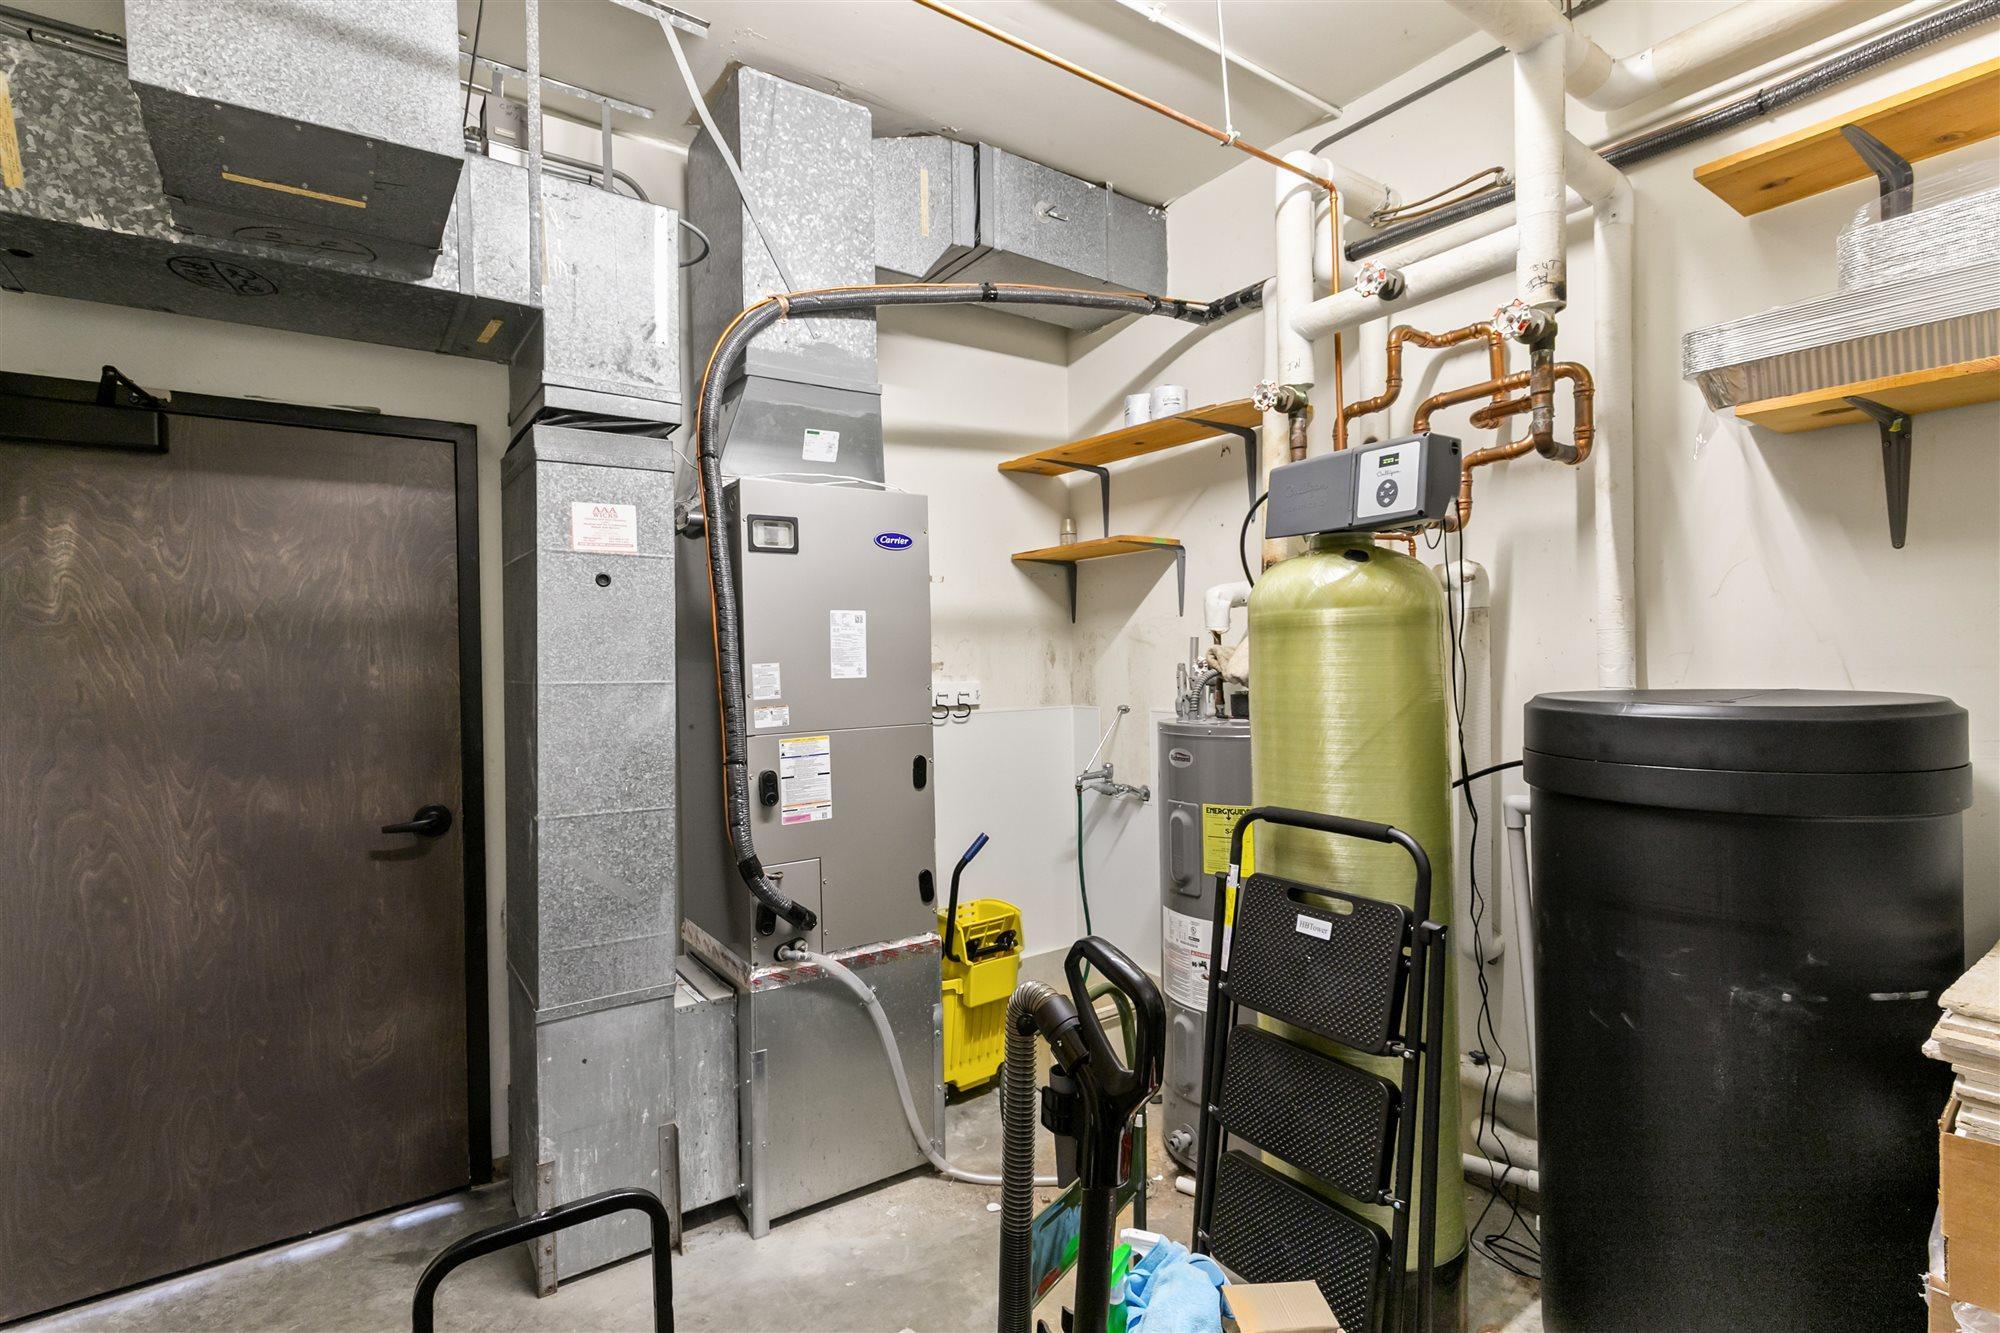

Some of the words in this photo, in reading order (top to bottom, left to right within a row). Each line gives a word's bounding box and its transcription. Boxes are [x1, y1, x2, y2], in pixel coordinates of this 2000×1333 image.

[592, 505, 617, 513] AAA
[879, 535, 909, 545] Carrier
[1299, 919, 1328, 934] HBTower
